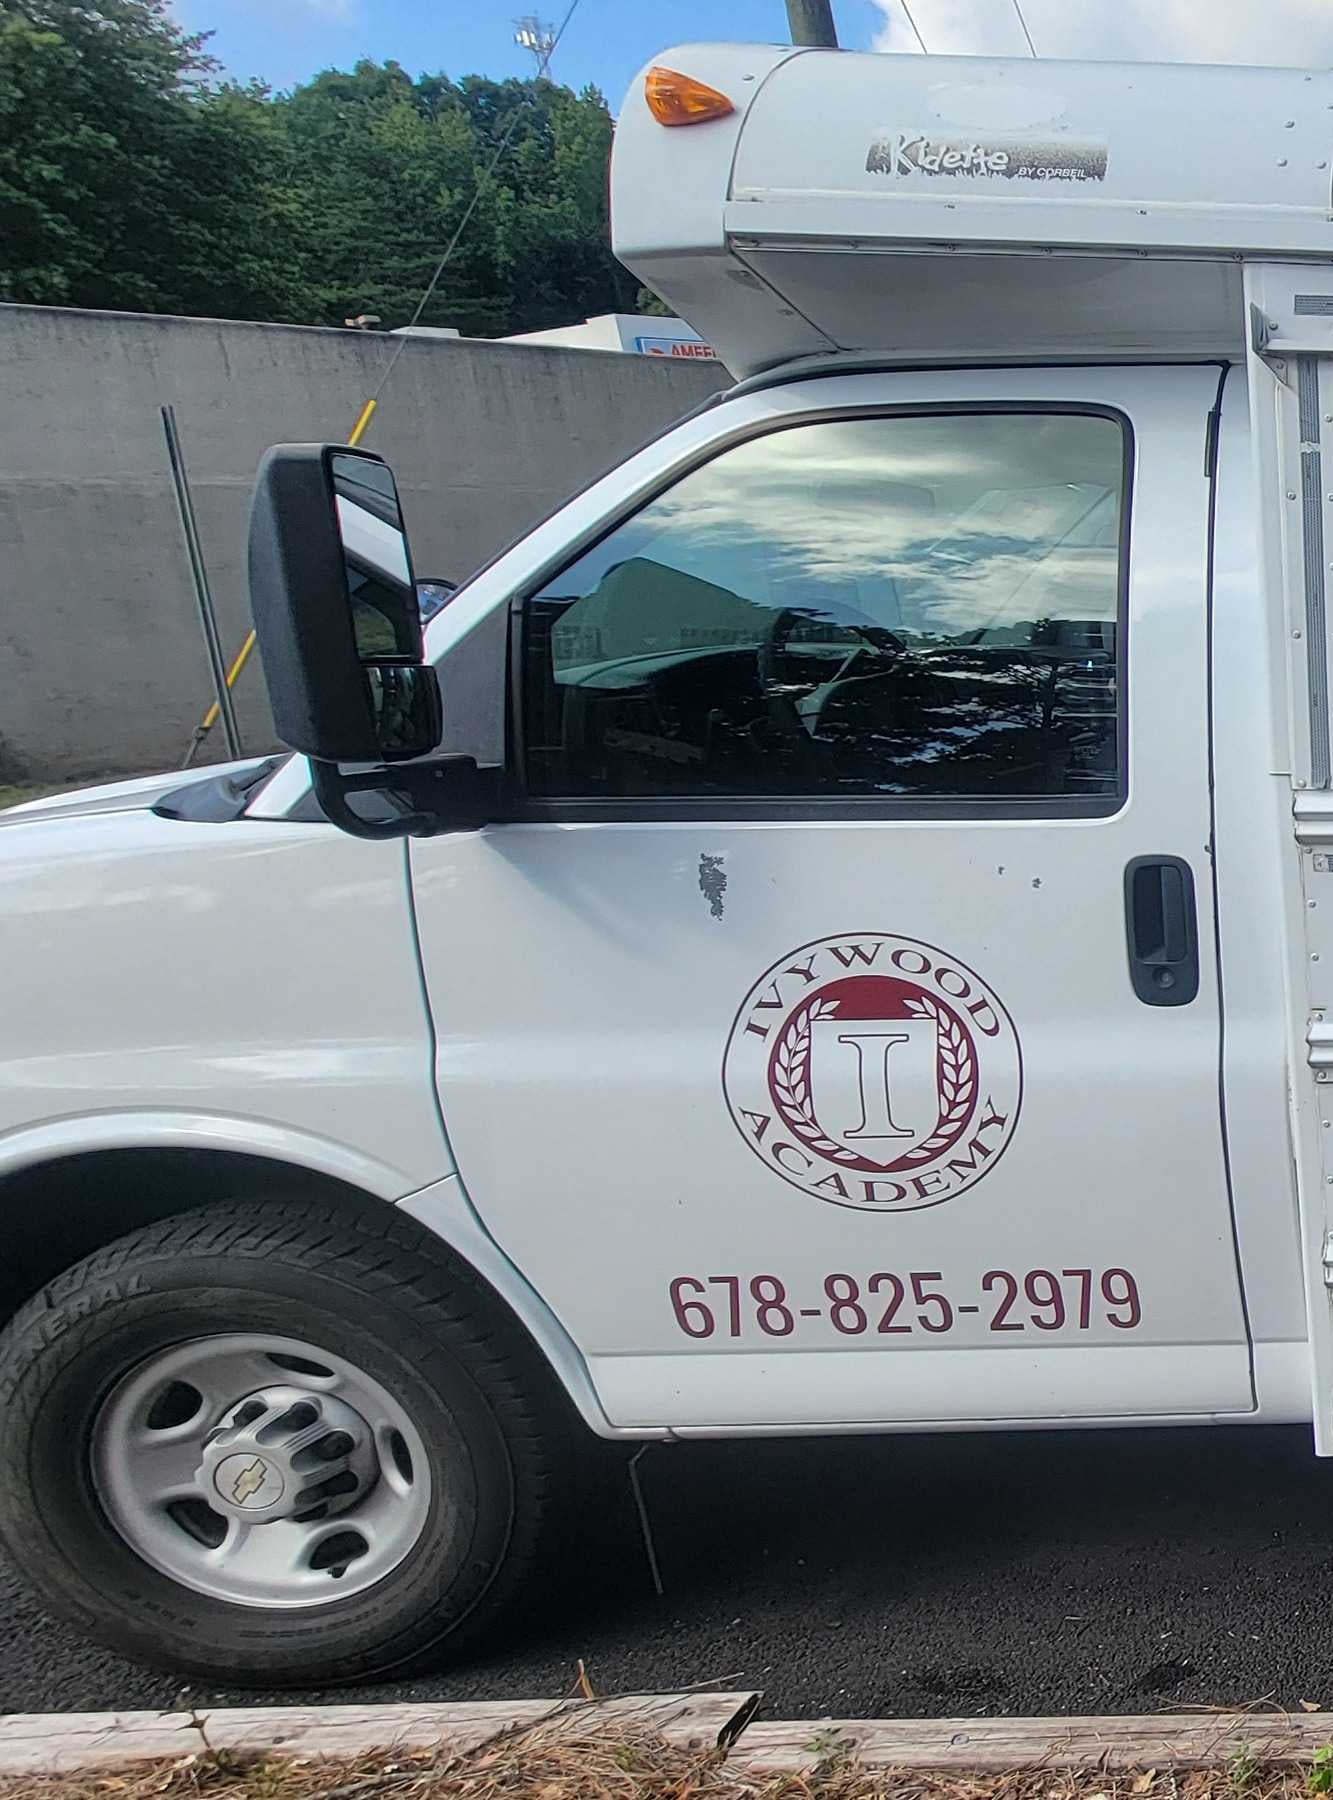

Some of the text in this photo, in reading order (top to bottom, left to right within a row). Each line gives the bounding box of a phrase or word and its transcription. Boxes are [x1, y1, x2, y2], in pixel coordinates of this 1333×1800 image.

[1018, 166, 1087, 178] BY CORBEIL
[671, 343, 717, 359] AME
[743, 942, 1001, 1042] IVYWOOD
[838, 1034, 915, 1139] I
[738, 1095, 1009, 1203] ACADEMY
[669, 1267, 1142, 1339] 678-825-2979
